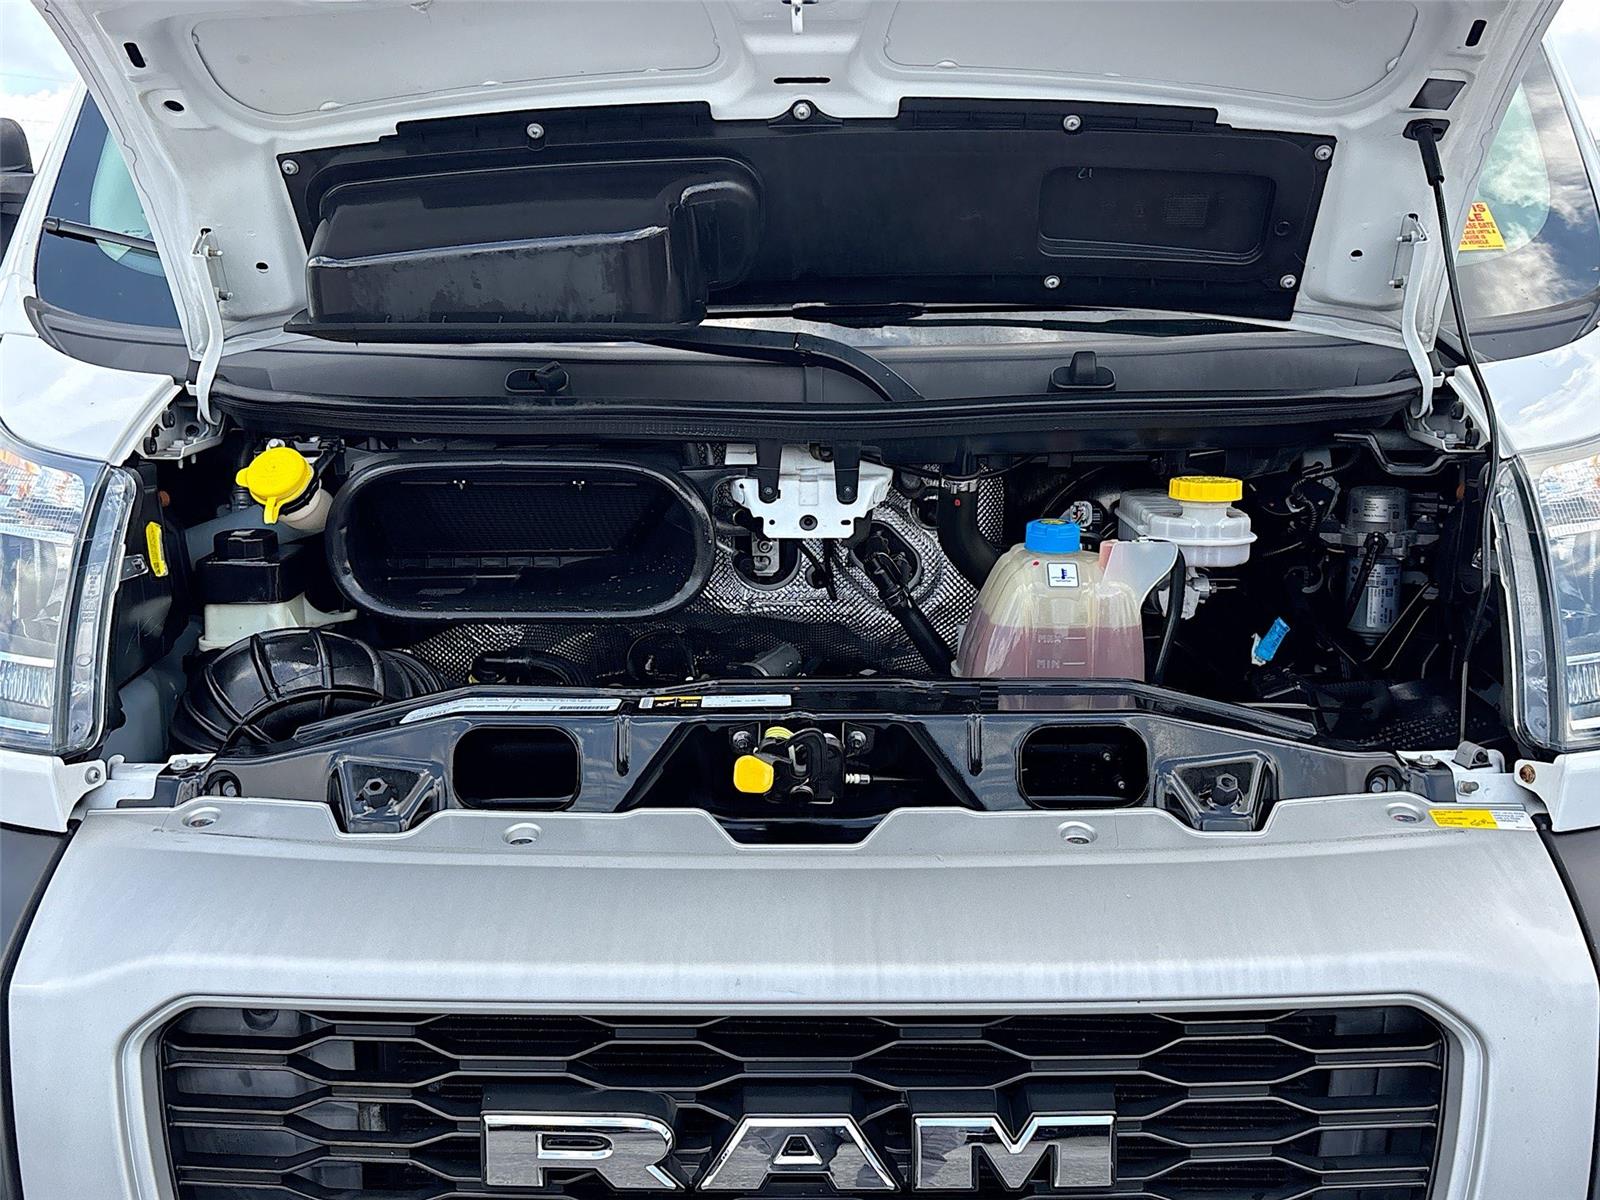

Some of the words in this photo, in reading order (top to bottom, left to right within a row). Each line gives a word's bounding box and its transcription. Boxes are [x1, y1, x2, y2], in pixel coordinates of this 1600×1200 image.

[1472, 204, 1486, 212] IS
[1036, 658, 1061, 669] MIN
[483, 1112, 1115, 1191] RAM
